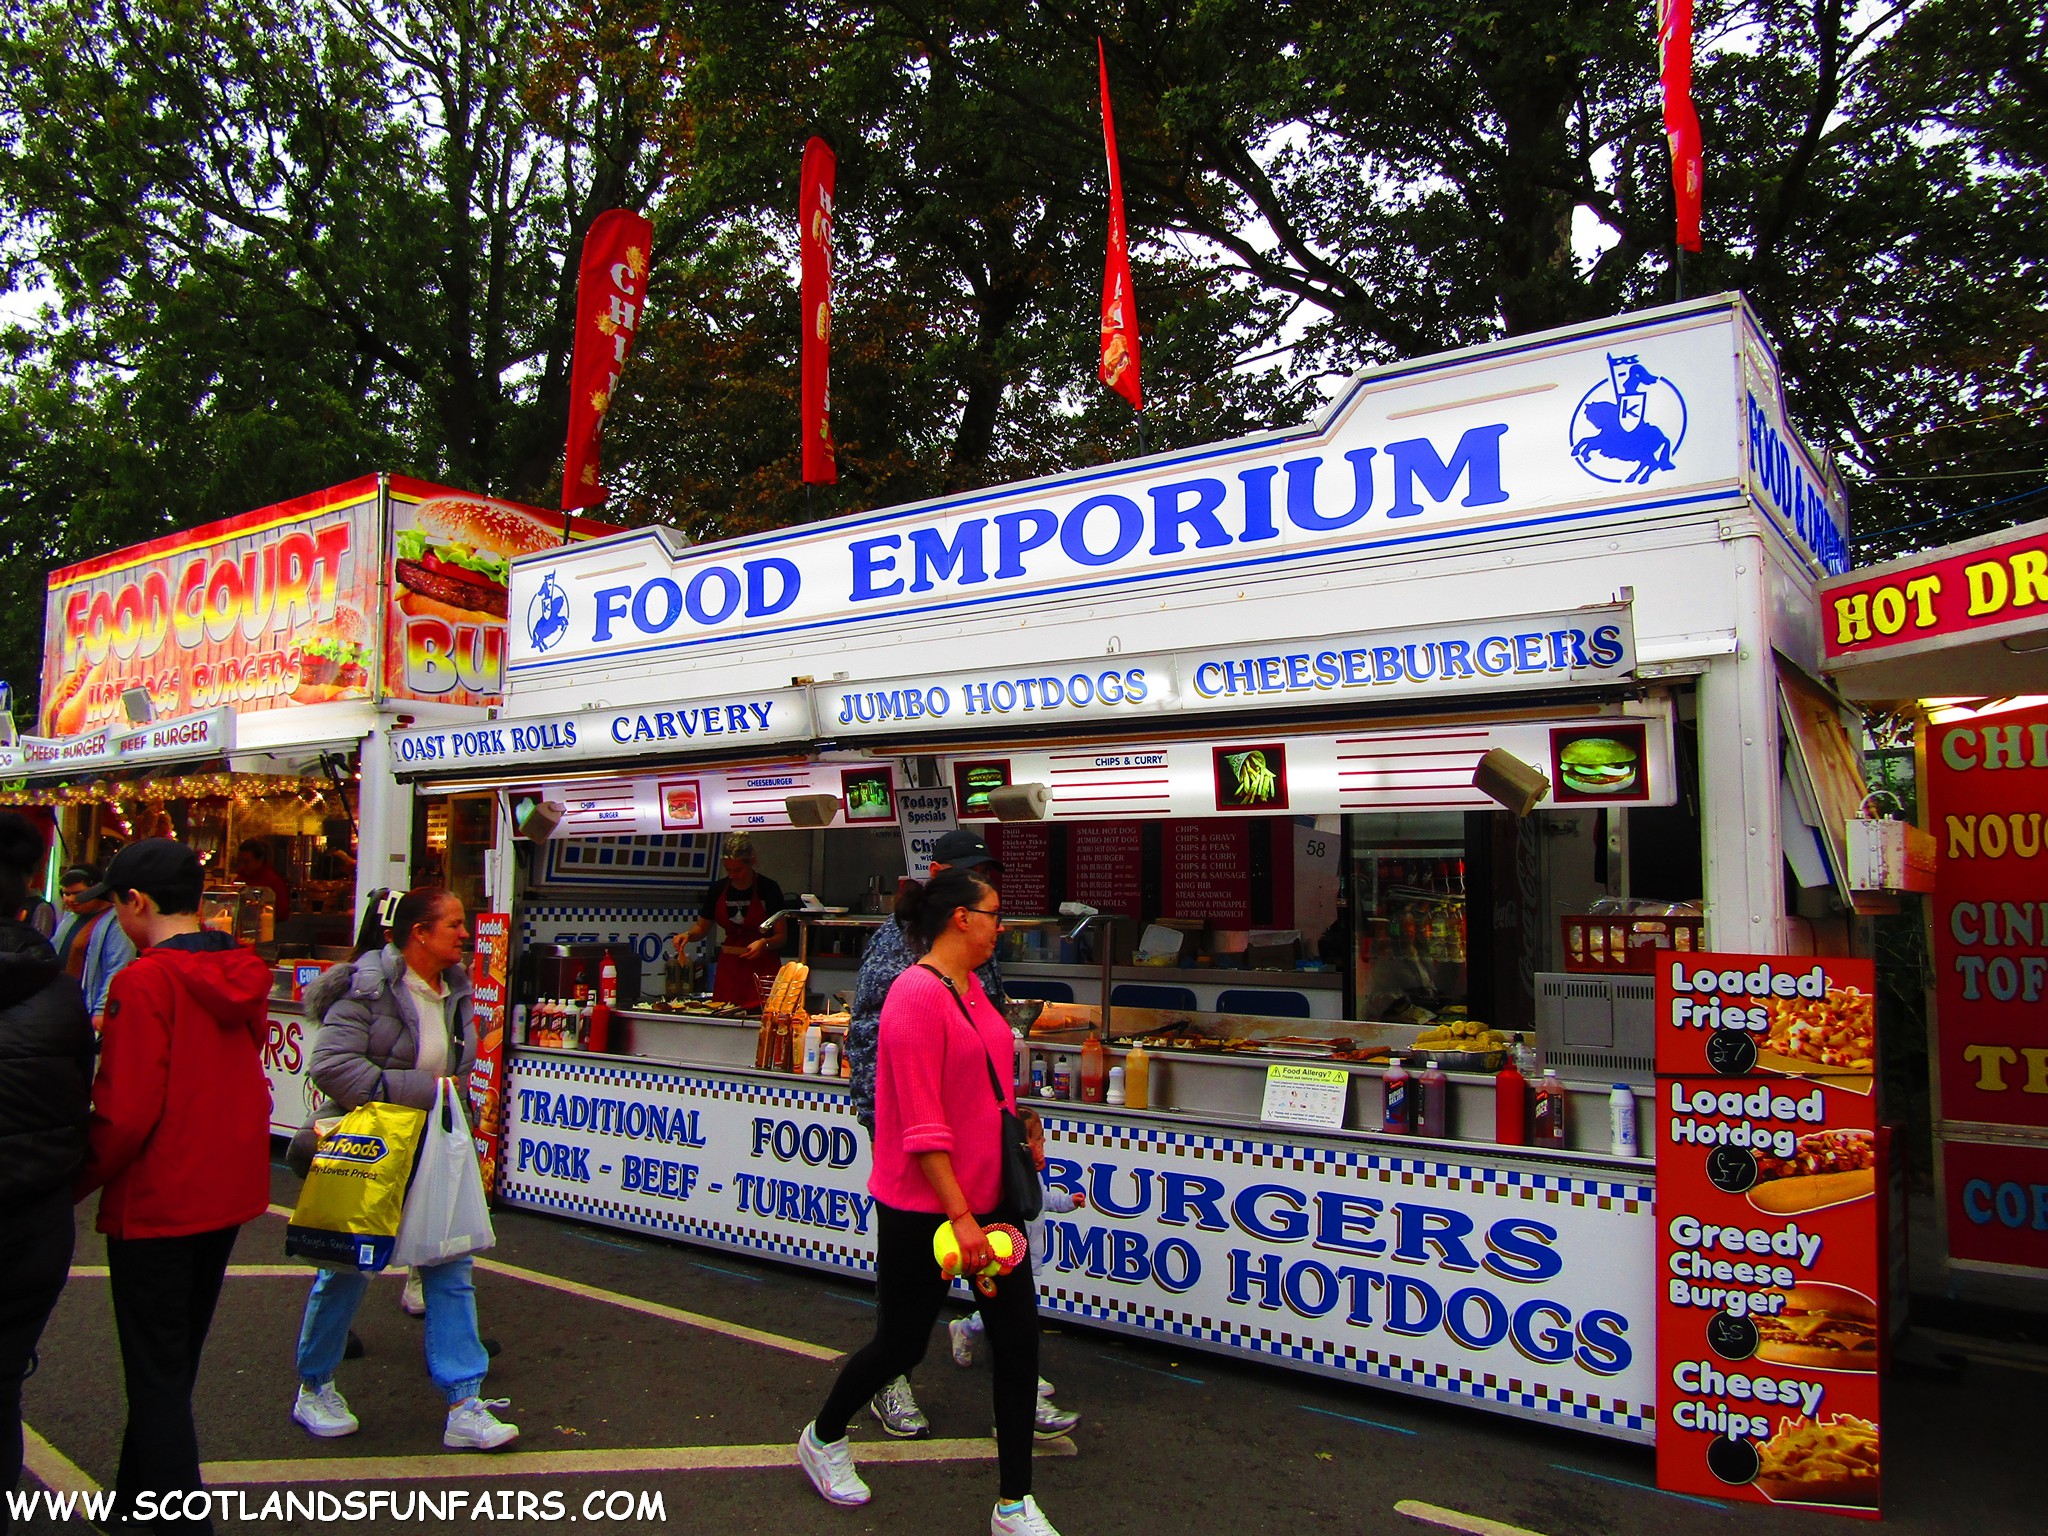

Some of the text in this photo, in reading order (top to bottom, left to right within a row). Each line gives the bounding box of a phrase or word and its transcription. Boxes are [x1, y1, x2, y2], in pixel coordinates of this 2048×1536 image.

[1748, 389, 1792, 519] FOOD
[1794, 465, 1806, 542] &
[592, 423, 1510, 642] FOOD EMPORIUM
[63, 521, 352, 673] FOOD COURT
[1834, 575, 1942, 644] HOT
[406, 617, 504, 696] BU
[1194, 625, 1624, 699] CHEESEBURGERS
[87, 678, 126, 723] HOT
[191, 646, 303, 709] BURGERS
[838, 668, 1149, 726] JUMBO HOTDOGS
[120, 720, 208, 752] BEEF BURGER
[452, 728, 506, 756] PORK
[510, 721, 578, 752] ROLLS
[611, 700, 774, 744] CARVERY
[23, 734, 107, 763] CHEESE BURGER
[1095, 755, 1164, 768] CHIPS & CURRY
[747, 778, 793, 787] CHEESEBURGER
[580, 801, 596, 809] CHIPS
[900, 795, 949, 811] Todays
[908, 811, 947, 824] Specials
[748, 816, 765, 824] CANS
[1076, 827, 1100, 835] SMALL
[1102, 827, 1118, 835] HOT
[1175, 825, 1199, 833] CHIPS
[911, 838, 938, 856] Chi
[1076, 836, 1102, 844] JUMBO
[1103, 836, 1120, 844] HOT
[1201, 834, 1207, 842] &
[1209, 834, 1237, 842] GRAVY
[1306, 839, 1325, 857] 58
[1945, 813, 2048, 858] NOU
[1175, 853, 1237, 861] CHIPS & CURRY
[1175, 862, 1236, 870] CHIPS & CHILLI
[1089, 872, 1113, 880] BURGER
[1175, 872, 1247, 880] CHIPS & SAUSAGE
[1197, 881, 1211, 889] RIB
[1103, 899, 1127, 907] ROLLS
[1175, 910, 1189, 918] HOT
[1208, 910, 1244, 918] SANDWICH
[478, 918, 502, 936] Loaded
[477, 936, 493, 955] Fries
[474, 983, 498, 1002] Loaded
[1671, 961, 1824, 998] Loaded
[1671, 996, 1768, 1031] Fries
[1713, 1038, 1747, 1063] £7
[1282, 1067, 1332, 1078] Food Allergy?
[1671, 1082, 1824, 1122] Loaded
[517, 1088, 858, 1169] TRADITIONAL FOOD
[1671, 1118, 1795, 1158] Hotdog
[323, 1166, 350, 1177] Lowest
[350, 1169, 378, 1181] Prices
[1714, 1153, 1747, 1183] £7
[517, 1137, 591, 1182] PORK
[622, 1153, 699, 1202] BEEF
[733, 1172, 877, 1235] TURKEY
[1044, 1156, 1563, 1285] BURGERS
[1669, 1215, 1822, 1267] Greedy
[1669, 1251, 1793, 1286] Cheese
[1041, 1217, 1634, 1376] UMBO HOTDOGS
[1669, 1279, 1785, 1317] Burger
[1672, 1361, 1824, 1416] Cheesy
[1672, 1401, 1768, 1441] Chips
